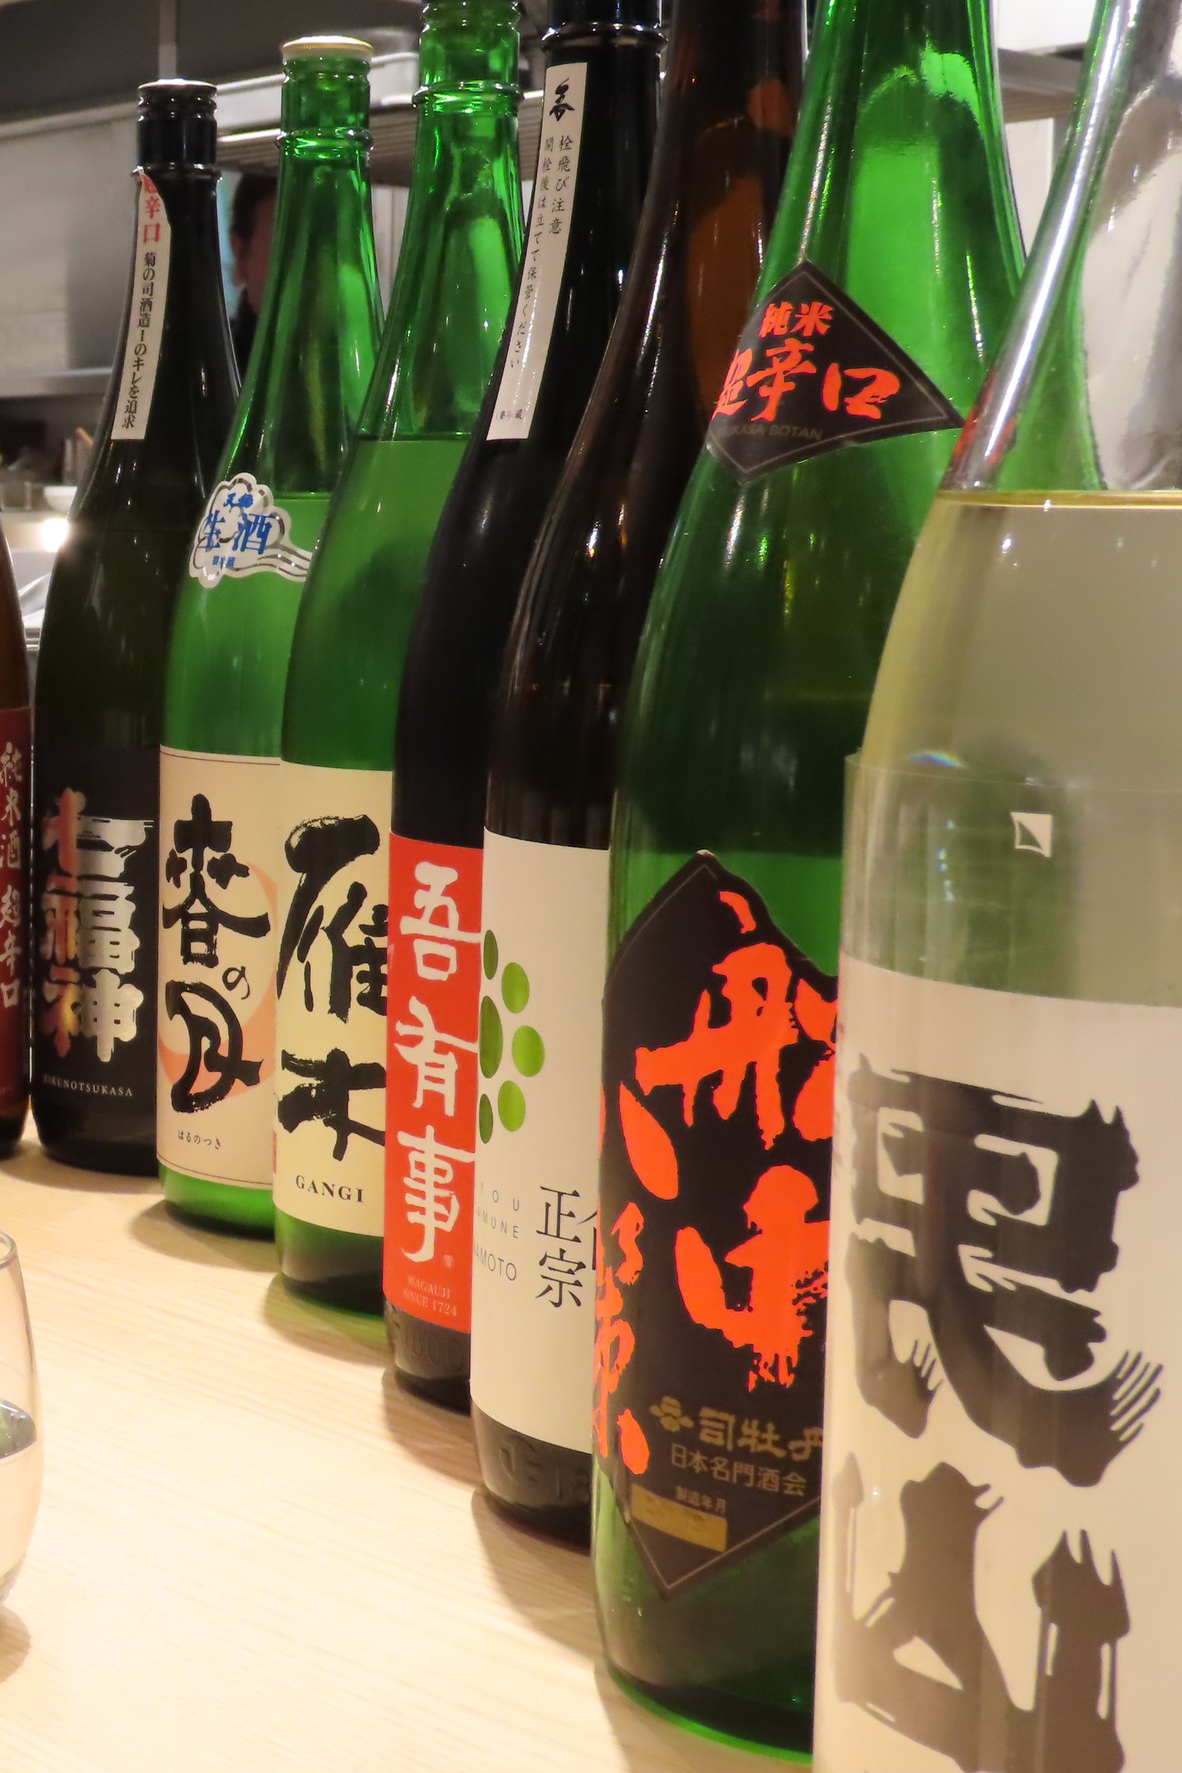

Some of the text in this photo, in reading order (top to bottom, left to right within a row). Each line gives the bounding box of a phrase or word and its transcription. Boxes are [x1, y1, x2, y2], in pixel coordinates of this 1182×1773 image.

[197, 509, 273, 555] 生酒
[295, 1174, 365, 1204] GANGI
[535, 1185, 587, 1308] 正宗
[670, 1442, 808, 1497] 日本名門酒会
